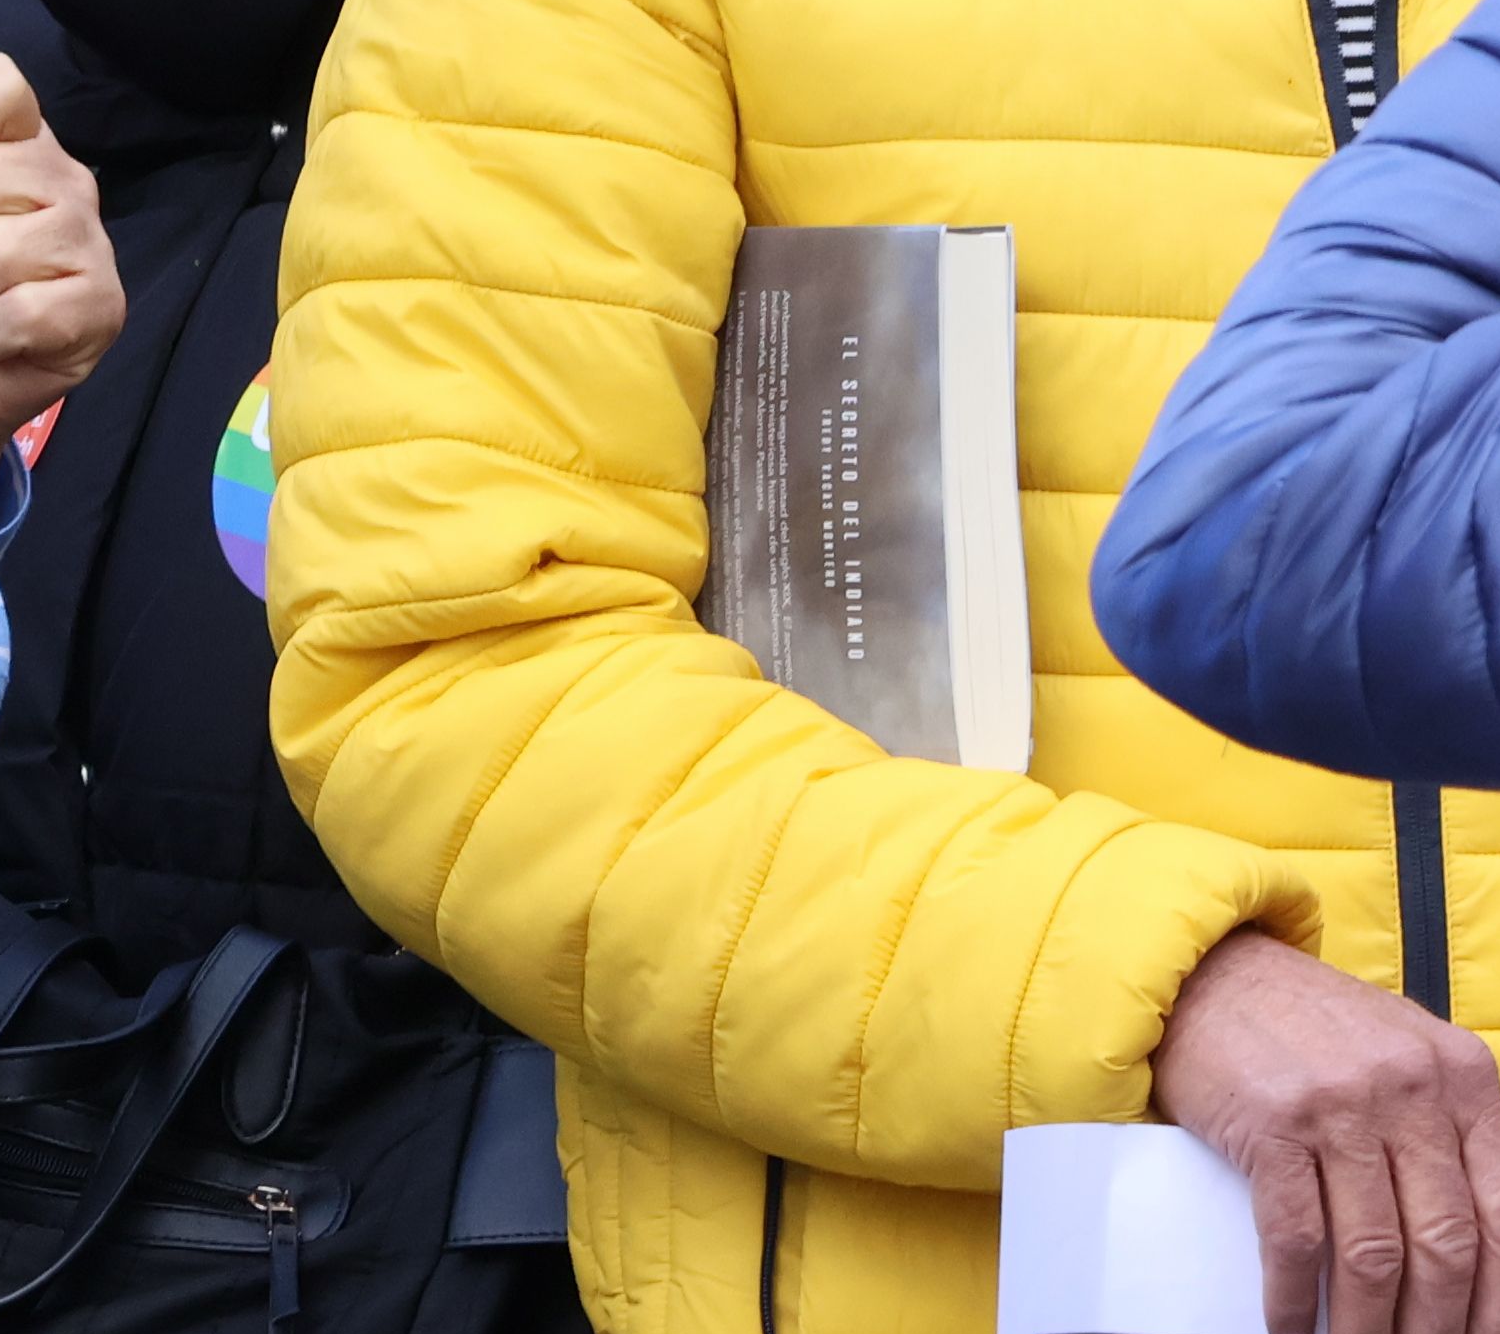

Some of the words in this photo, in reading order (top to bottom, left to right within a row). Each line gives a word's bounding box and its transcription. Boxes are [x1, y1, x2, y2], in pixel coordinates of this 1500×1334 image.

[781, 290, 791, 376] Ambientada
[842, 337, 858, 360] EL
[757, 397, 766, 448] Alonso
[777, 414, 788, 475] segunda
[842, 380, 858, 482] SECRETO
[843, 501, 859, 541] DEL
[822, 520, 836, 588] MONTERO
[845, 560, 864, 660] INDIANO
